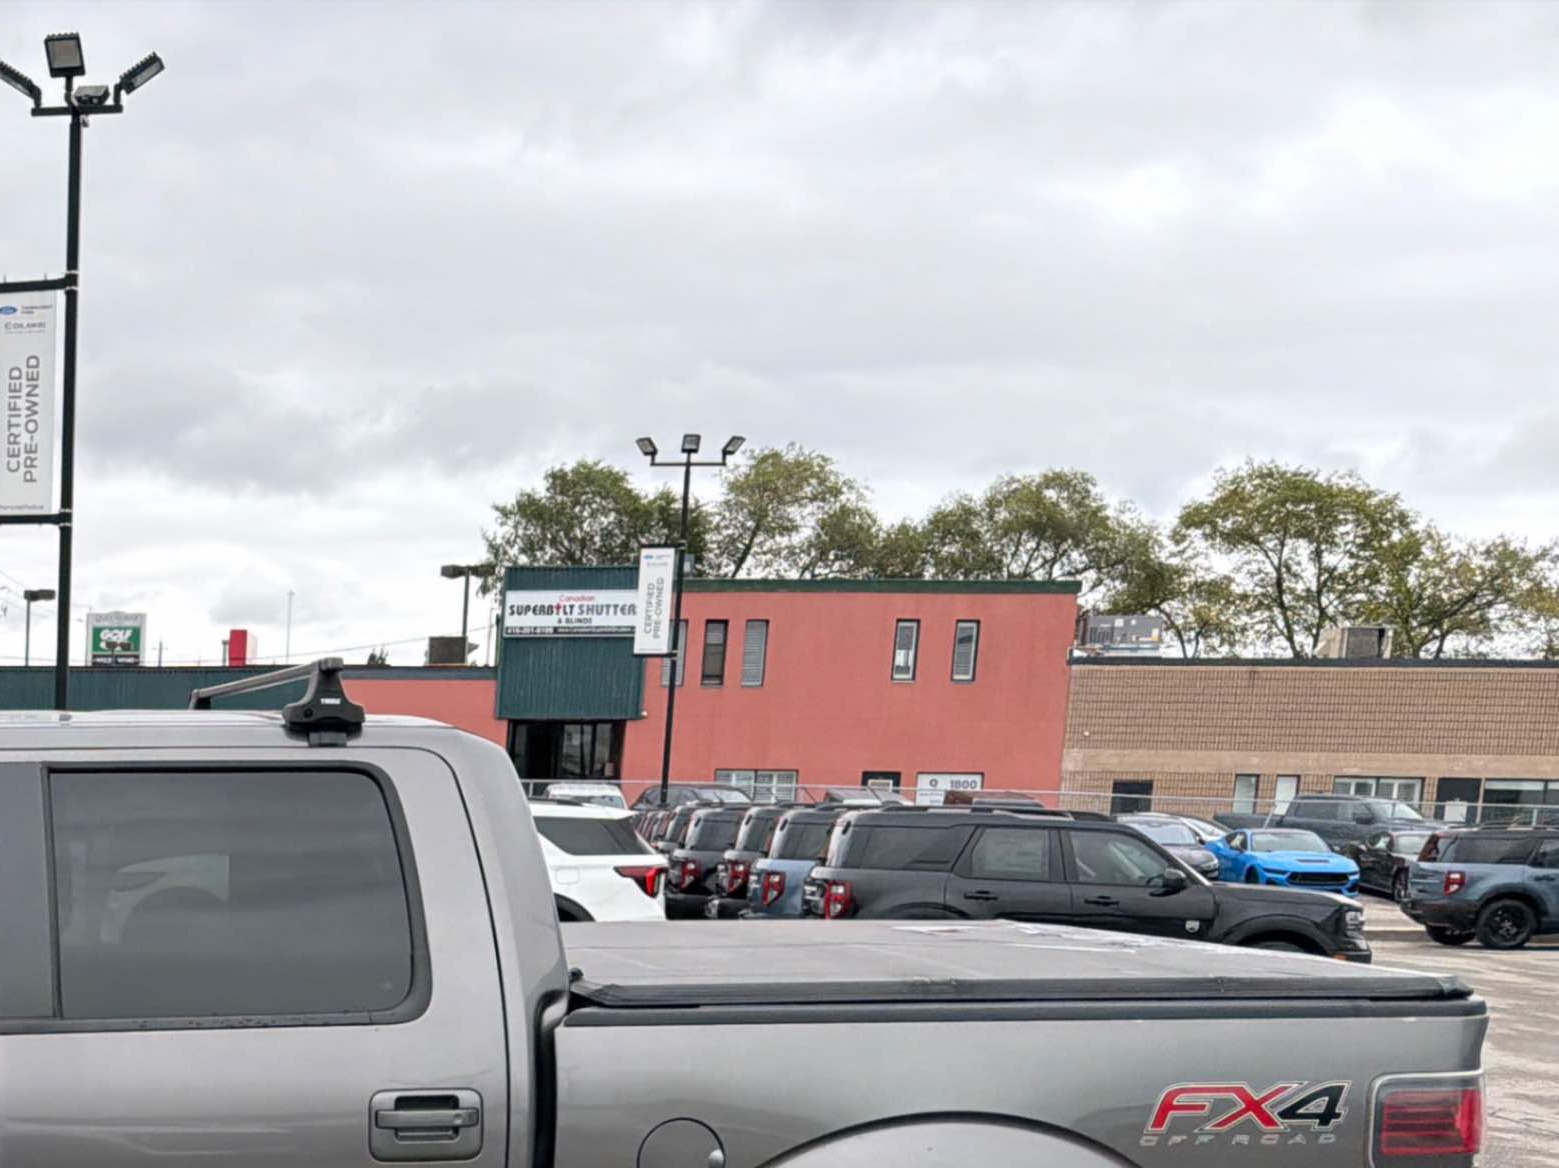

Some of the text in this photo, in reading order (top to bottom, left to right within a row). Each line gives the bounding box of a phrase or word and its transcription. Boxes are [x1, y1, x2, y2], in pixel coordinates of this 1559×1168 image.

[7, 366, 23, 473] CERTIFIED
[24, 354, 40, 483] PRE-OWNED
[644, 583, 655, 634] CERTIFIED
[653, 577, 664, 639] PRE-OWNED
[99, 629, 133, 641] GOLF
[949, 779, 977, 789] 1800
[1144, 1081, 1352, 1132] FX4
[1139, 1133, 1337, 1147] OFF ROAD
